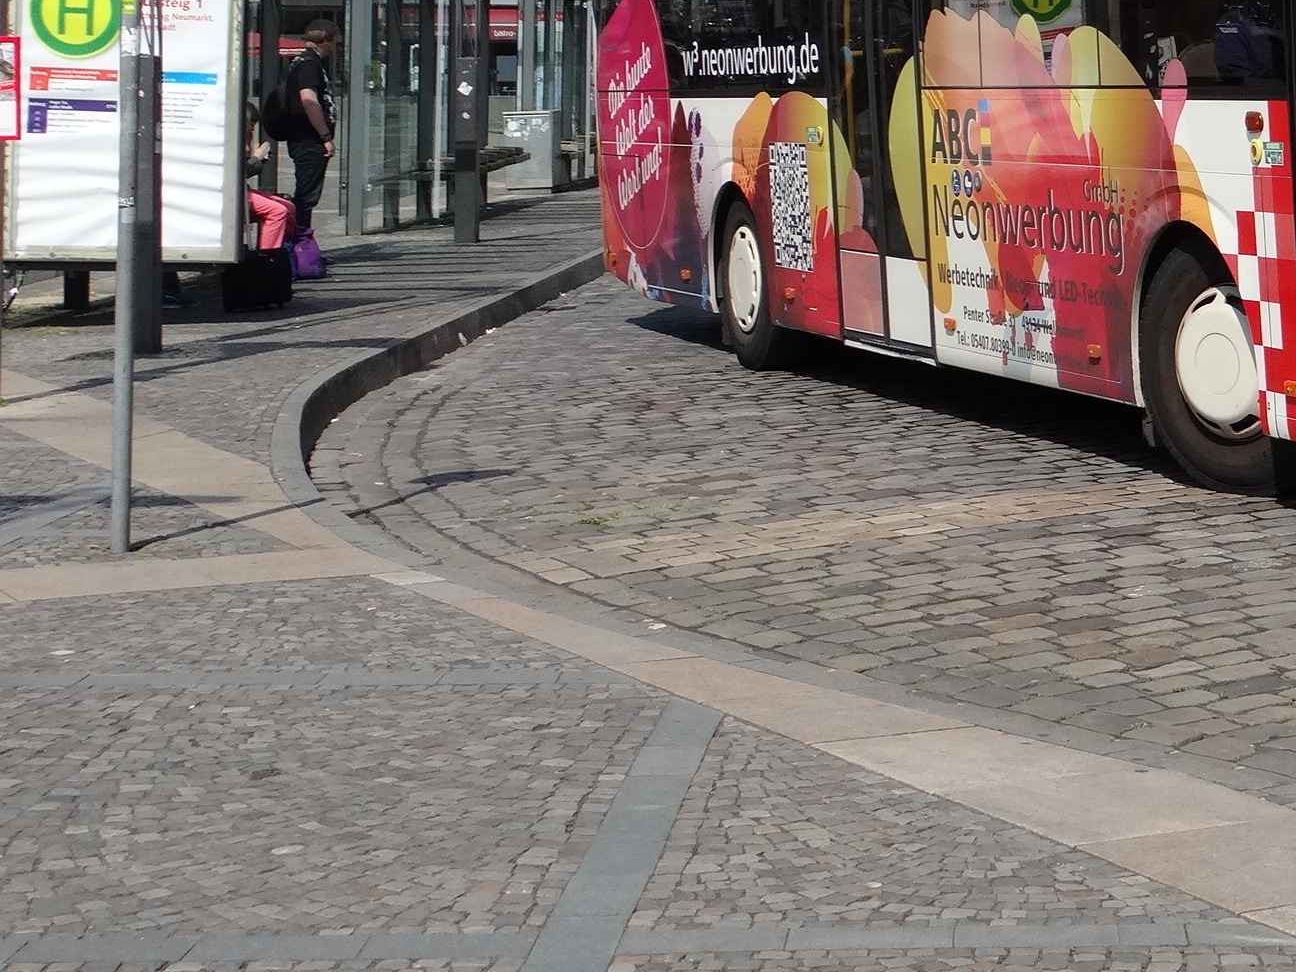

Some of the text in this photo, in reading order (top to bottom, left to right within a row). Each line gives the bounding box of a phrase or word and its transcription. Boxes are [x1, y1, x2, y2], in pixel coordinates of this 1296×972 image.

[626, 42, 652, 97] bunte
[616, 93, 655, 160] Welt der
[931, 108, 982, 166] ABC
[618, 126, 662, 210] Werbung!
[1083, 178, 1121, 204] GmbH
[933, 184, 1125, 276] Neonwerbung
[963, 305, 984, 323] Penter
